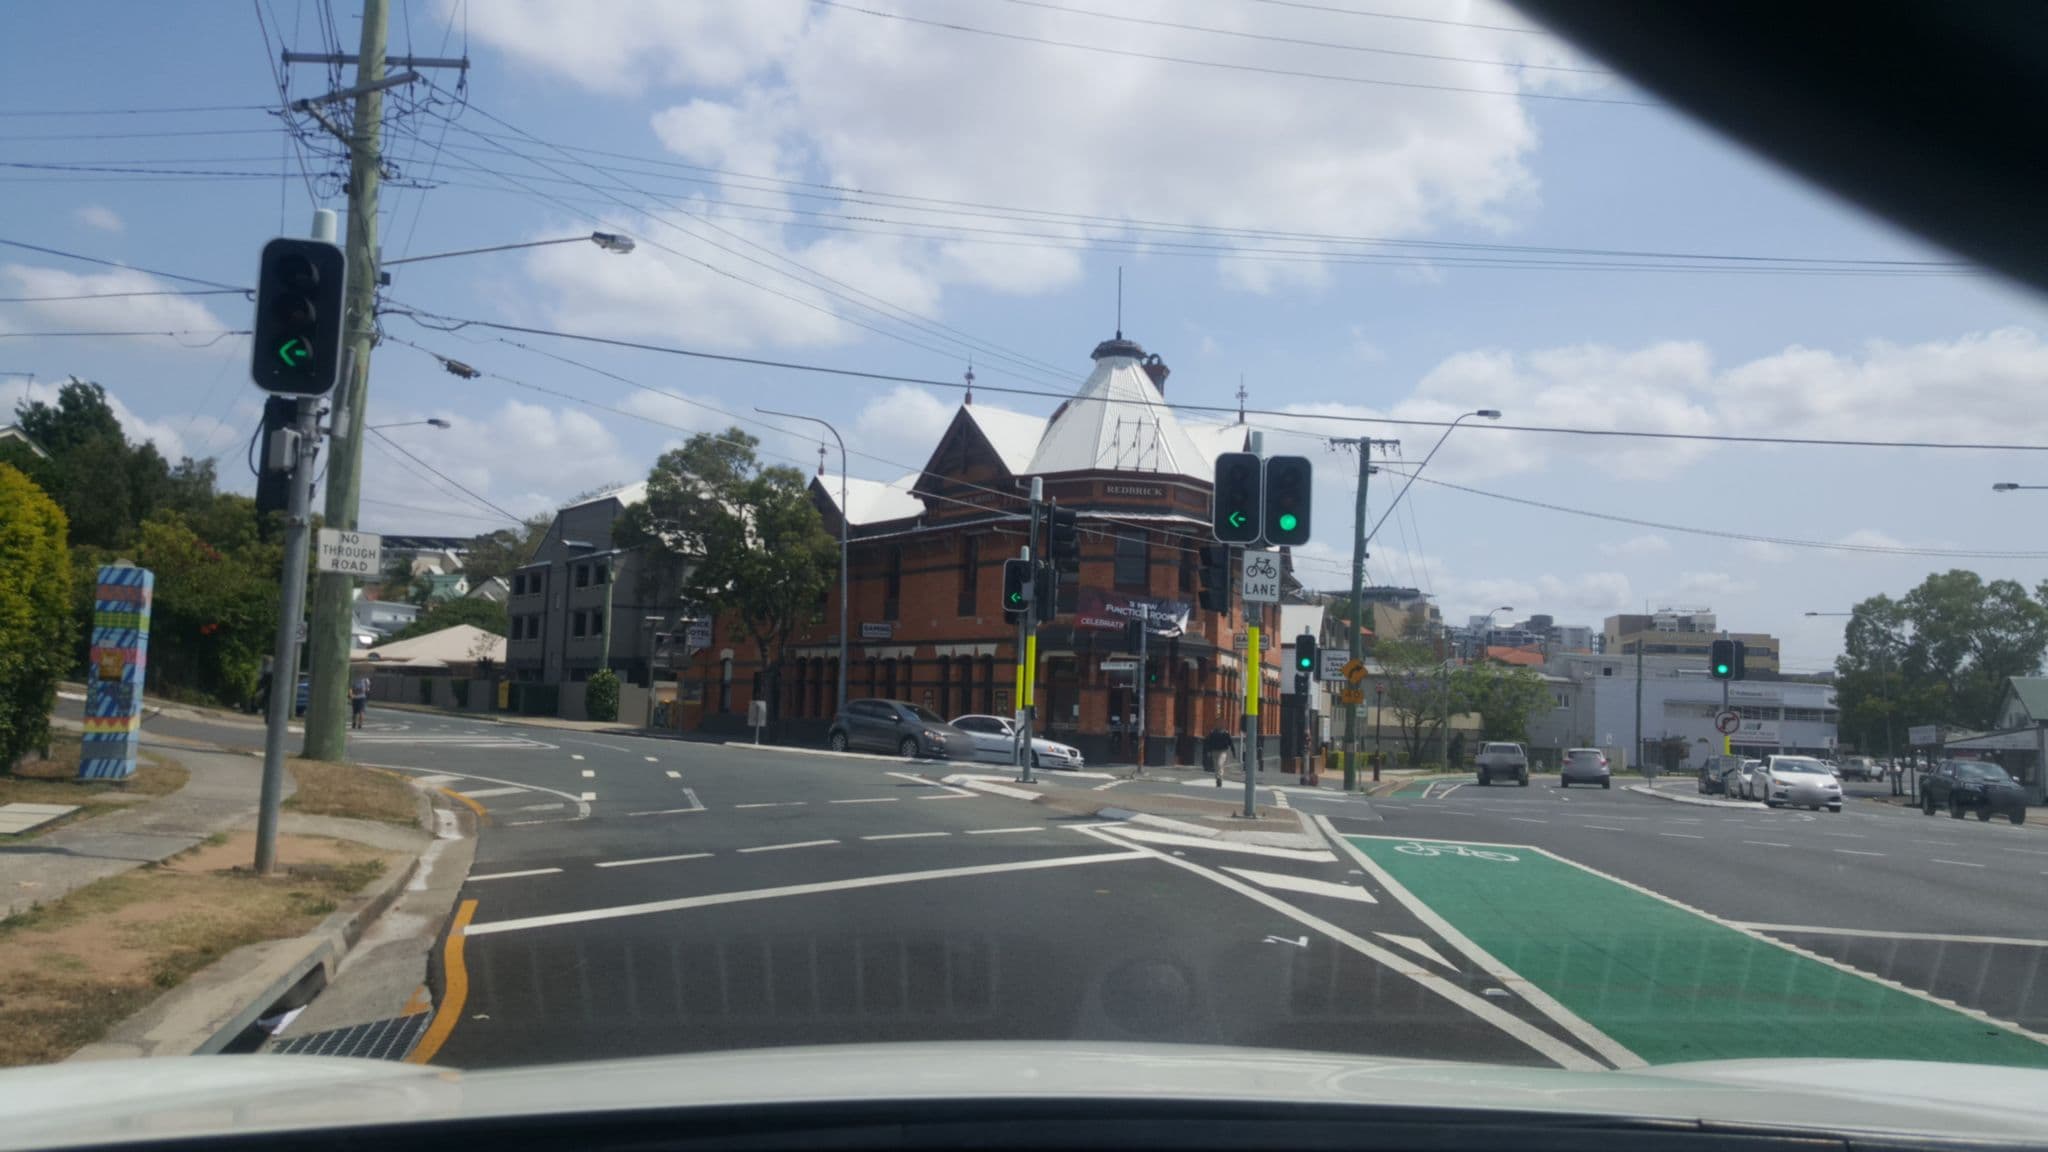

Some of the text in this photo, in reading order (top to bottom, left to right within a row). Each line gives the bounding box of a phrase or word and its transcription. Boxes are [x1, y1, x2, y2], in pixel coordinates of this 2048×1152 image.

[1107, 485, 1163, 496] REDBRICK
[340, 533, 360, 545] NO
[322, 544, 377, 559] THROUGH
[331, 558, 368, 572] ROAD
[1245, 583, 1276, 596] LANE
[1105, 604, 1147, 618] FUNCTIO
